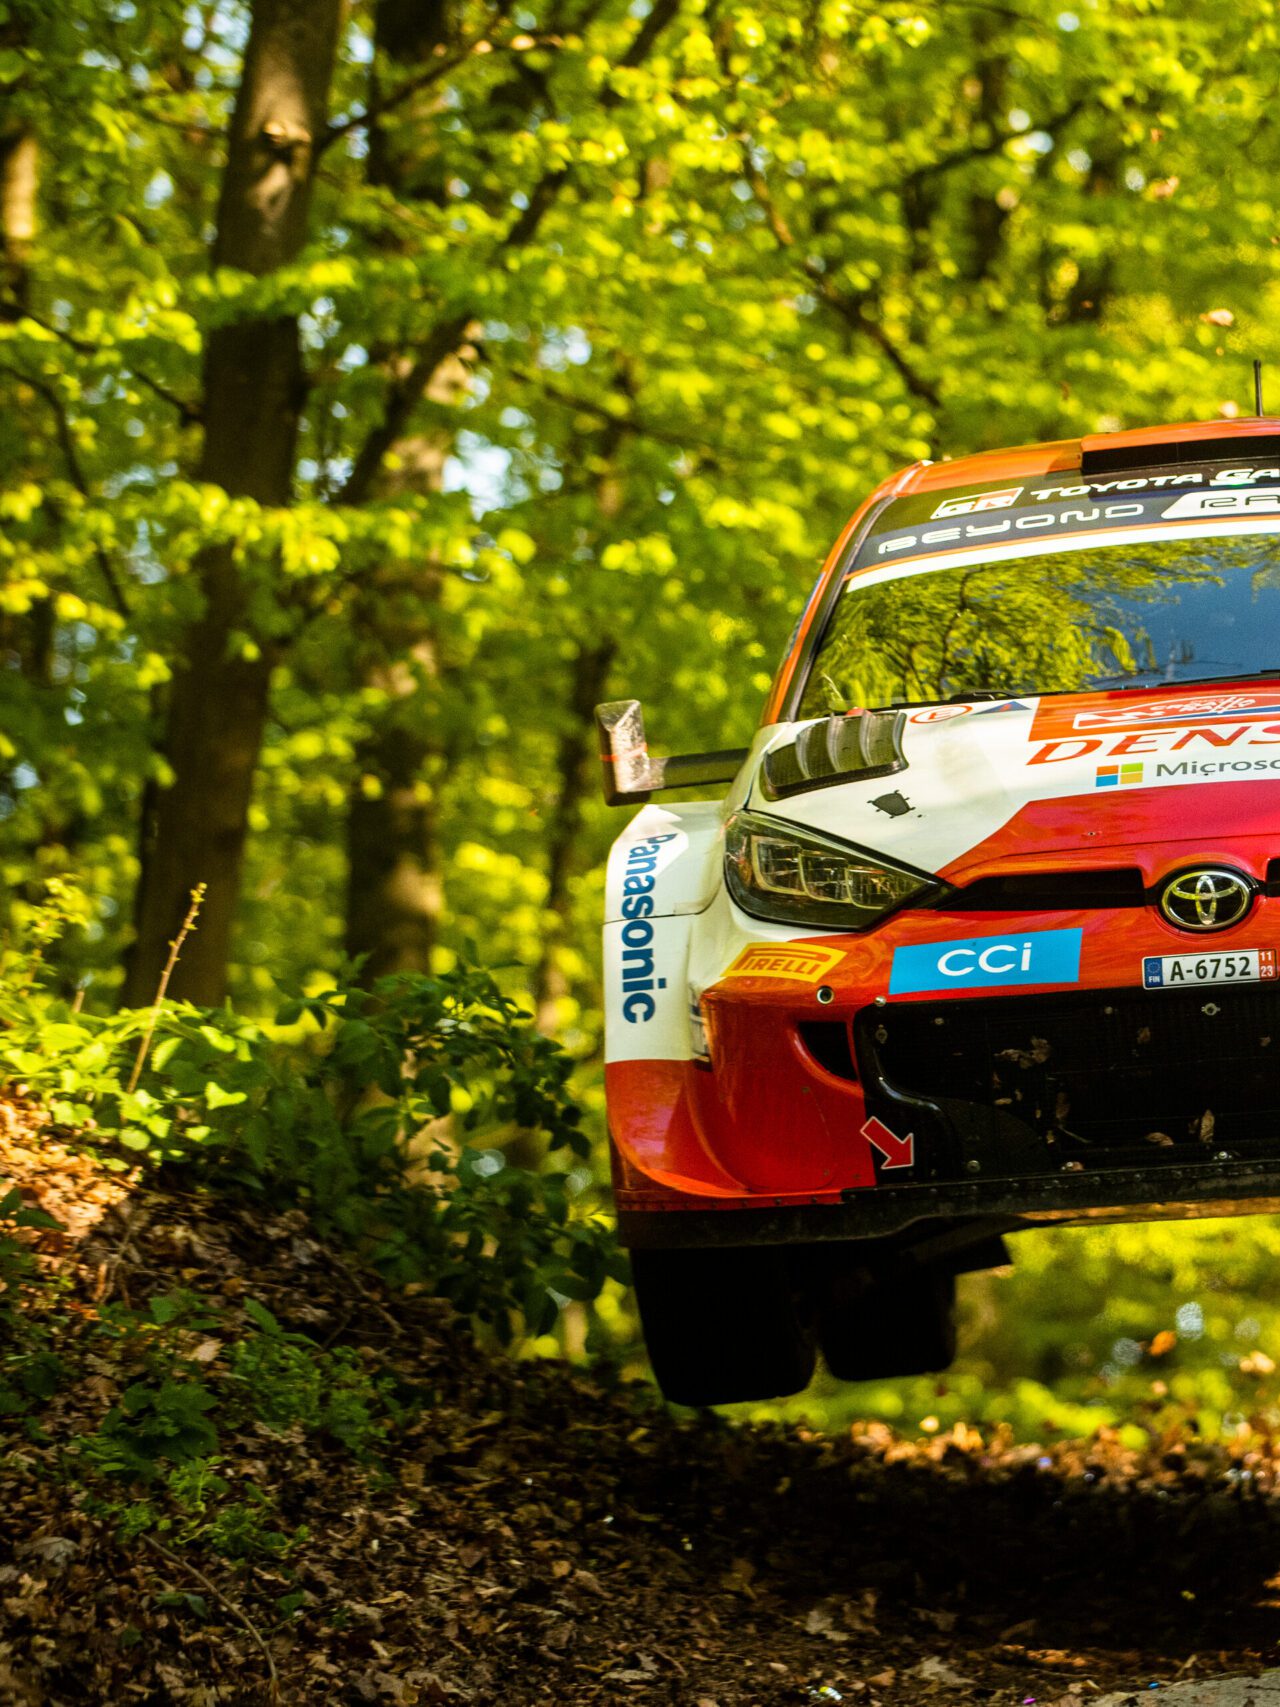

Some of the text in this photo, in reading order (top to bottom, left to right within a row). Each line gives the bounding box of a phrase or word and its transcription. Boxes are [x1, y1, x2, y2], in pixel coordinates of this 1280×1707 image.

[1030, 472, 1203, 500] TOYOTA
[878, 503, 1144, 554] BEYOND
[621, 832, 679, 1024] Panasonic
[731, 947, 832, 976] PIRELLI
[1148, 956, 1252, 983] FIN A-6752
[1259, 951, 1273, 961] 11
[1260, 965, 1274, 977] 23
